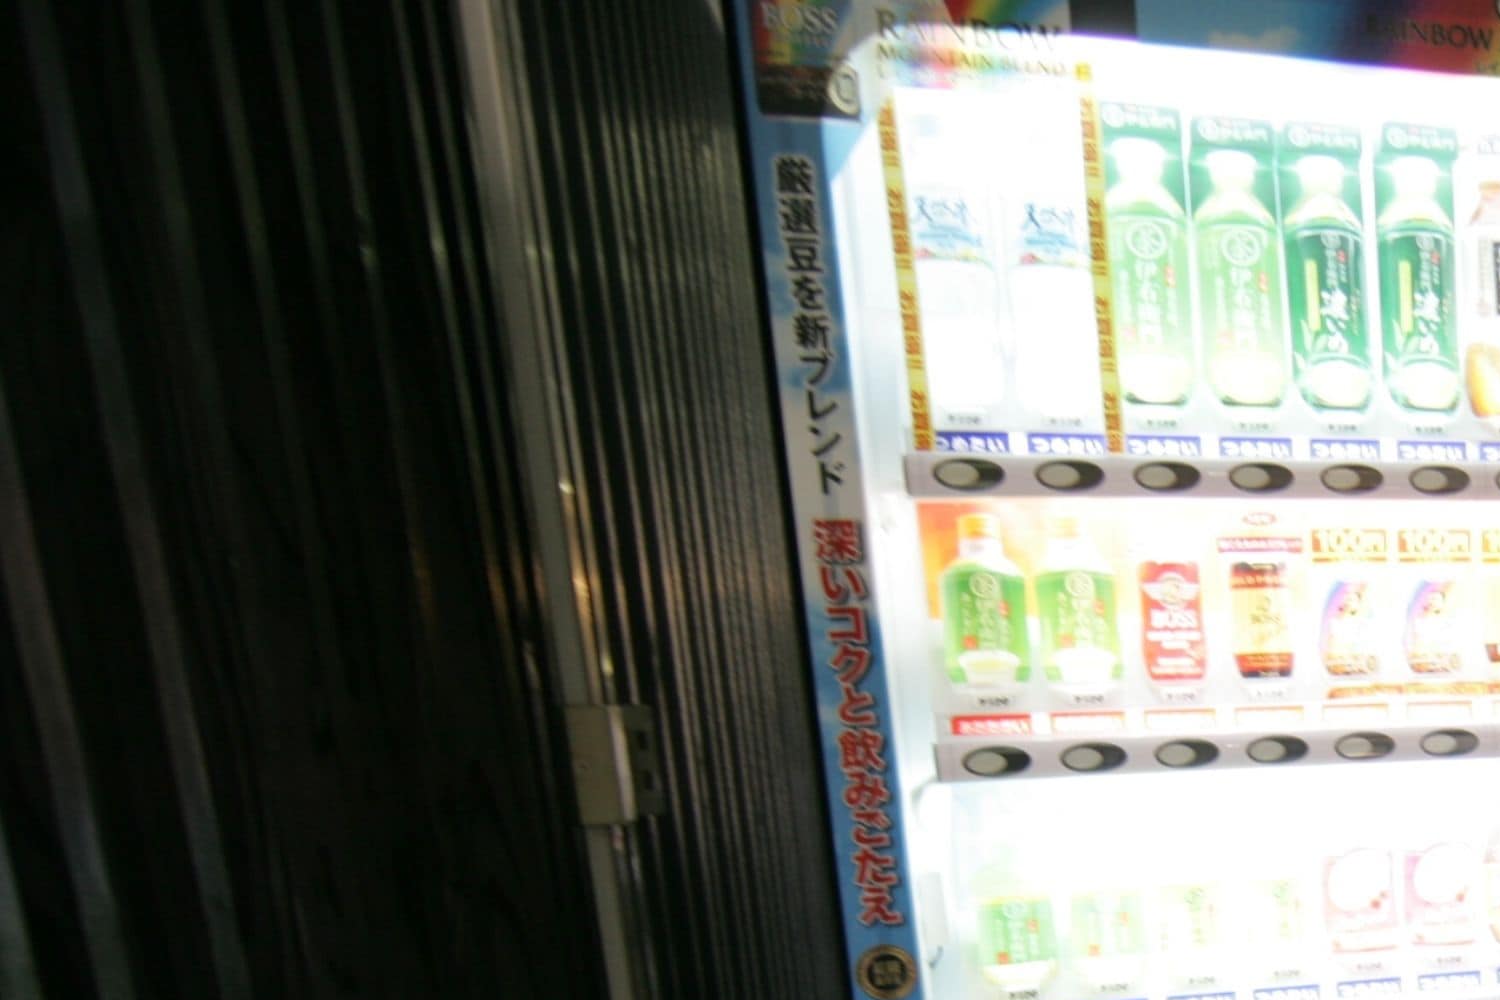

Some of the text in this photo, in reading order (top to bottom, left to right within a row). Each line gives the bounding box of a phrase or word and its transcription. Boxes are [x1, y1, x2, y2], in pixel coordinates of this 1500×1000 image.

[1366, 15, 1492, 50] RAINBOW
[774, 155, 846, 494] 厳選豆を新ブレンド
[812, 519, 903, 925] 深いコクと飲みごたえ
